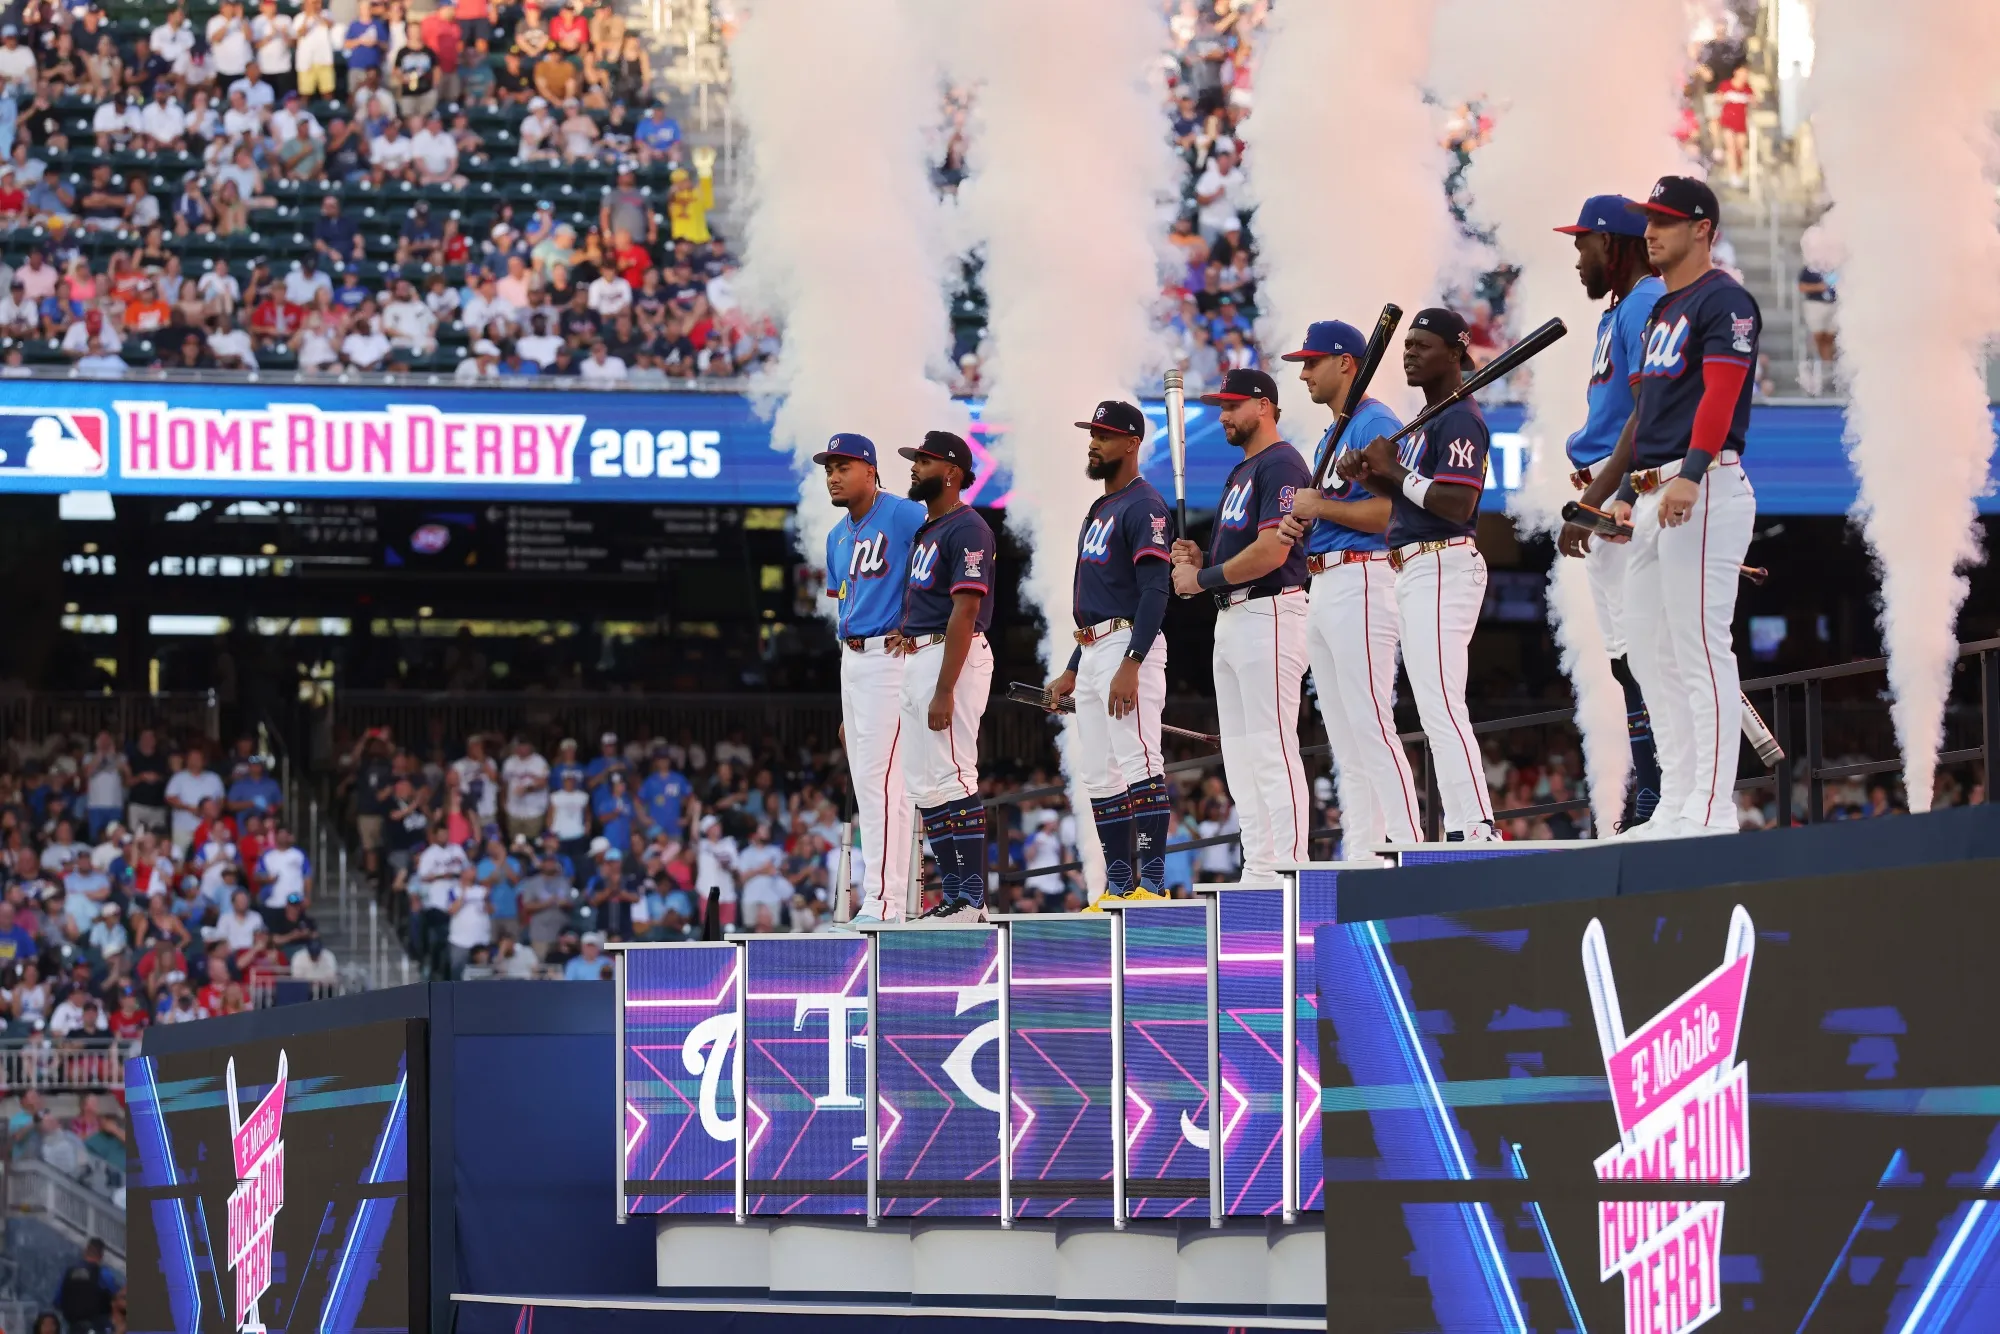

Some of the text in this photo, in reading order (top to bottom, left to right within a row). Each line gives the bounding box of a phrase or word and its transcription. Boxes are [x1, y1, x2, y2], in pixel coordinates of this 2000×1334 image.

[1644, 314, 1688, 372] al
[129, 411, 721, 479] HOME RUN DERBY 2025
[1447, 437, 1475, 469] NY
[1221, 479, 1252, 525] al
[849, 530, 887, 577] nl
[1082, 515, 1115, 559] al
[1651, 1003, 1720, 1095] Mobile
[249, 1106, 276, 1160] Mobile
[1683, 1076, 1745, 1190] RUN
[228, 1152, 283, 1265] HOME RUN
[237, 1224, 273, 1324] DERBY
[1627, 1207, 1719, 1334] DERBY
